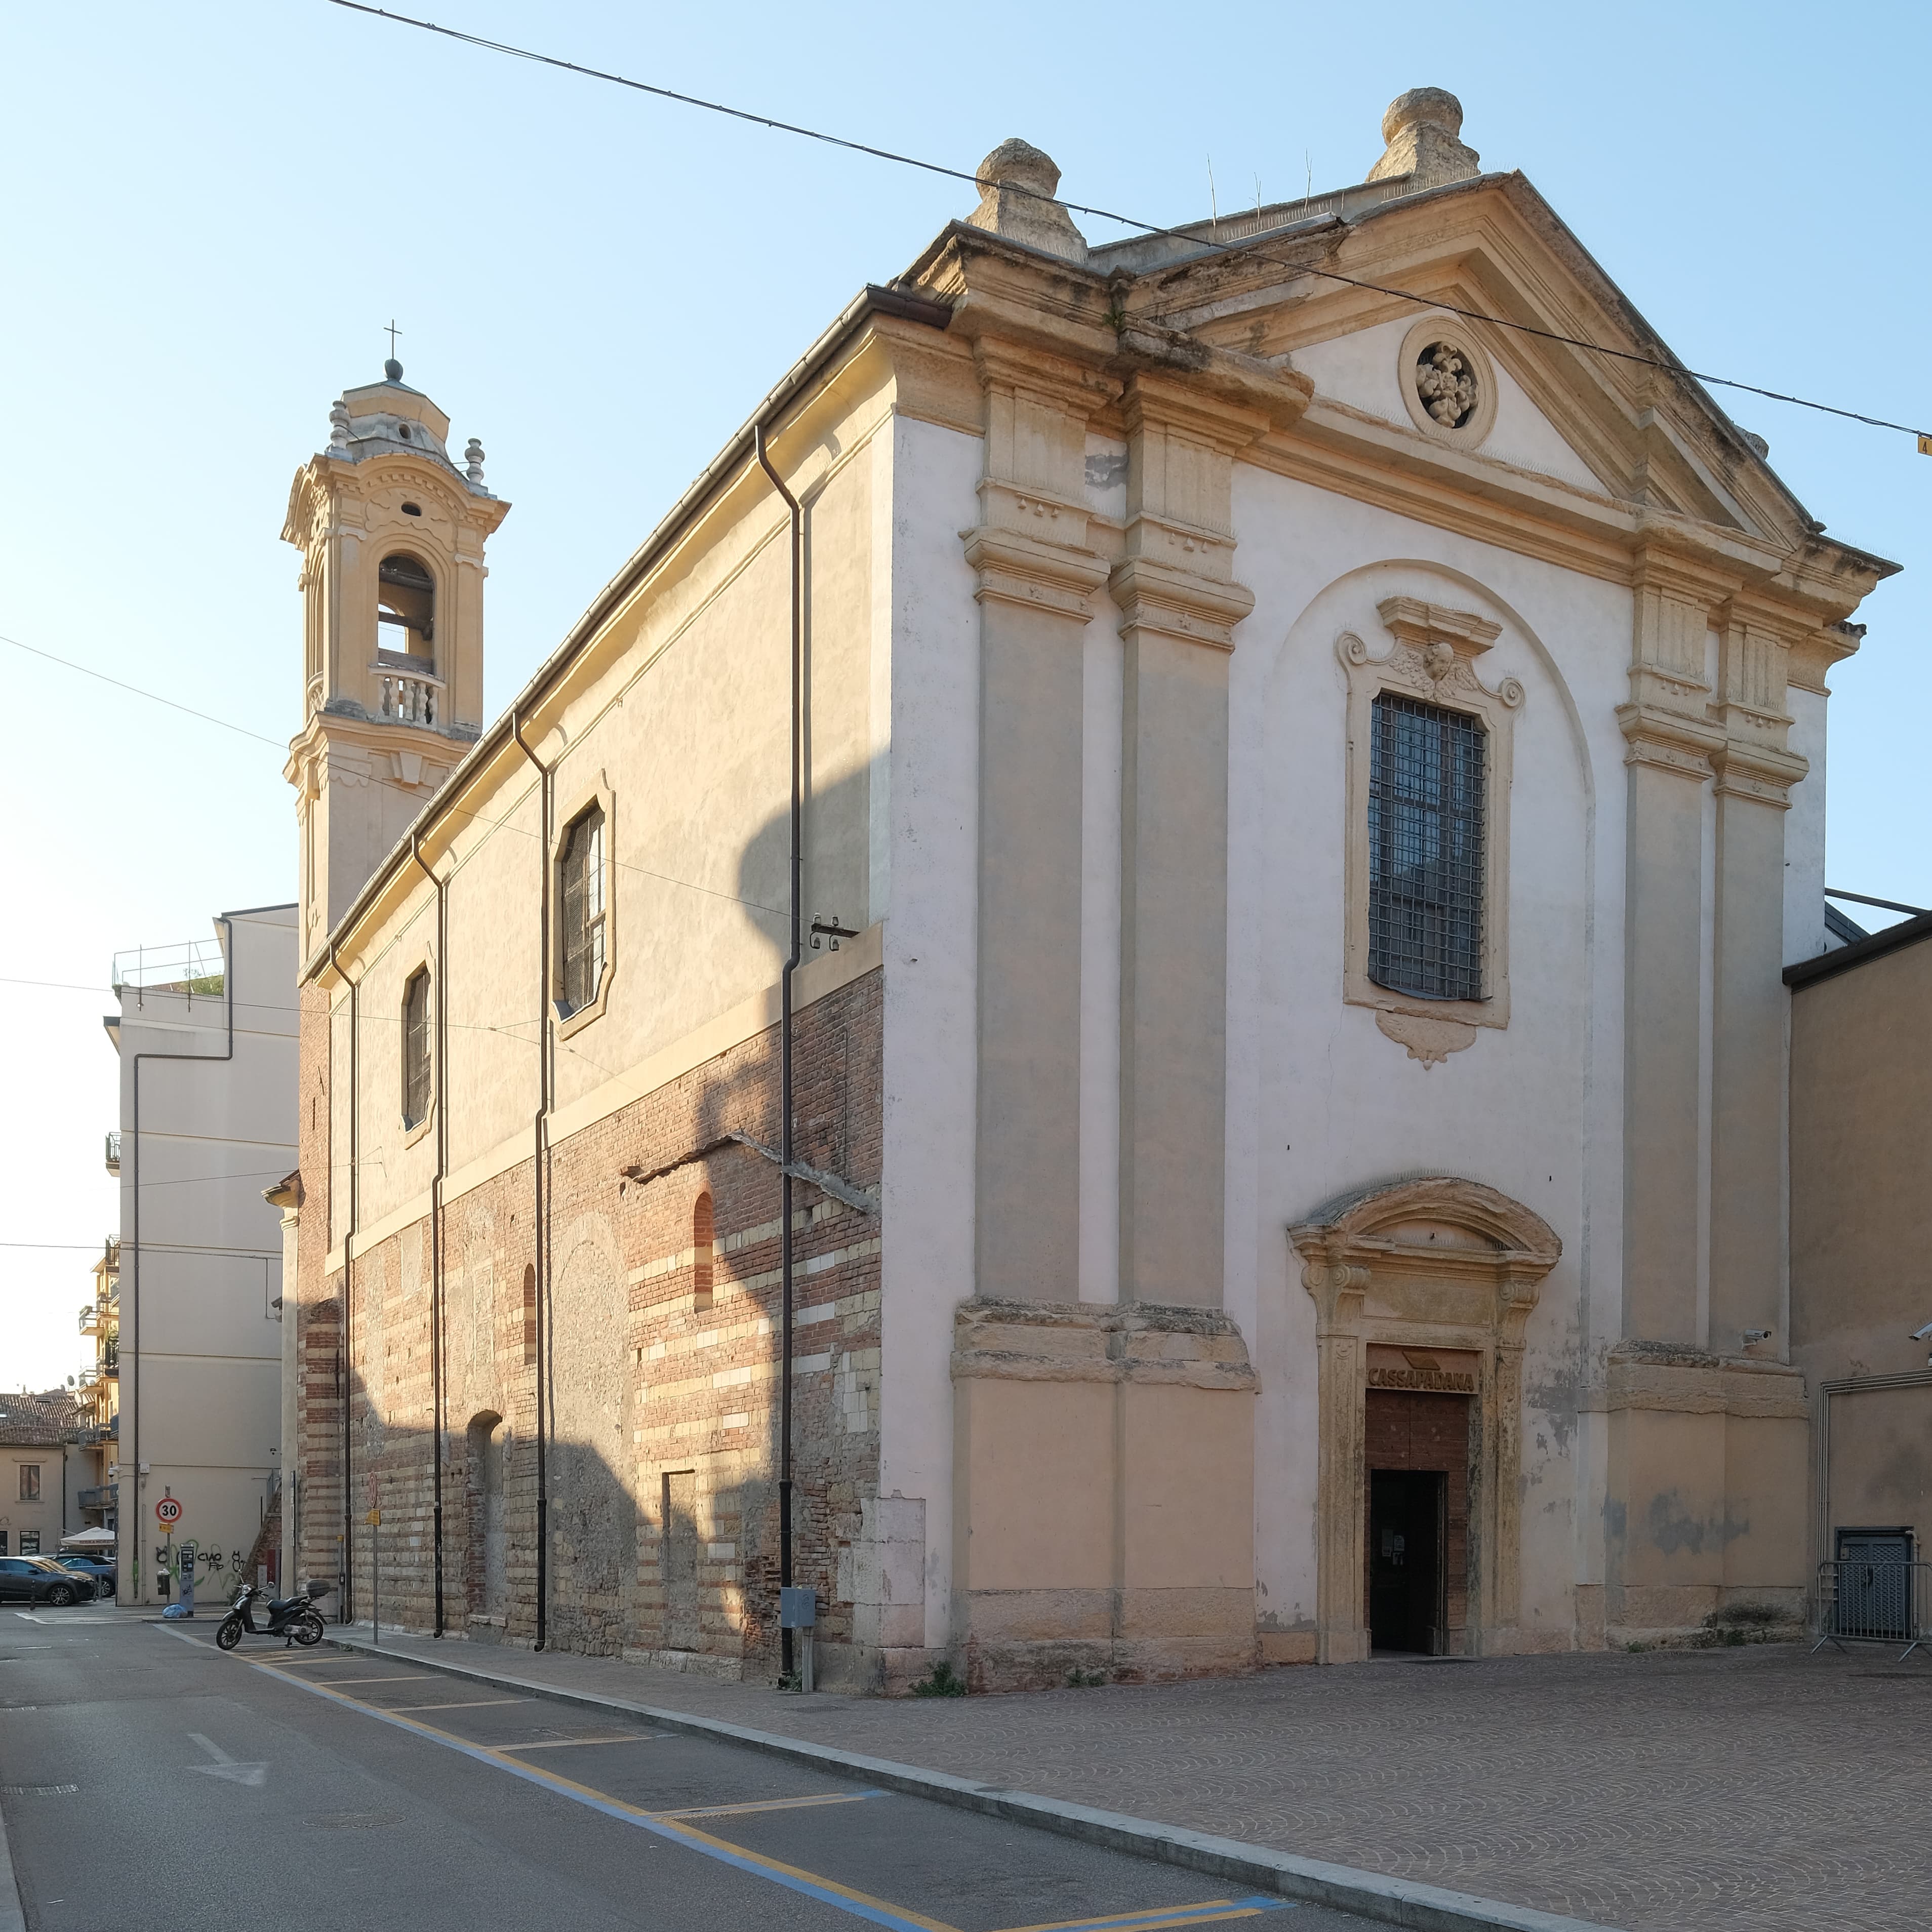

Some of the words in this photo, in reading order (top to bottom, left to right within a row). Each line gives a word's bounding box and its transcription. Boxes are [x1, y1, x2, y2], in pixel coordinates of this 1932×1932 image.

[1368, 1368, 1474, 1391] CASSAPADANA
[162, 1505, 177, 1516] 30
[197, 1552, 222, 1562] CIAO
